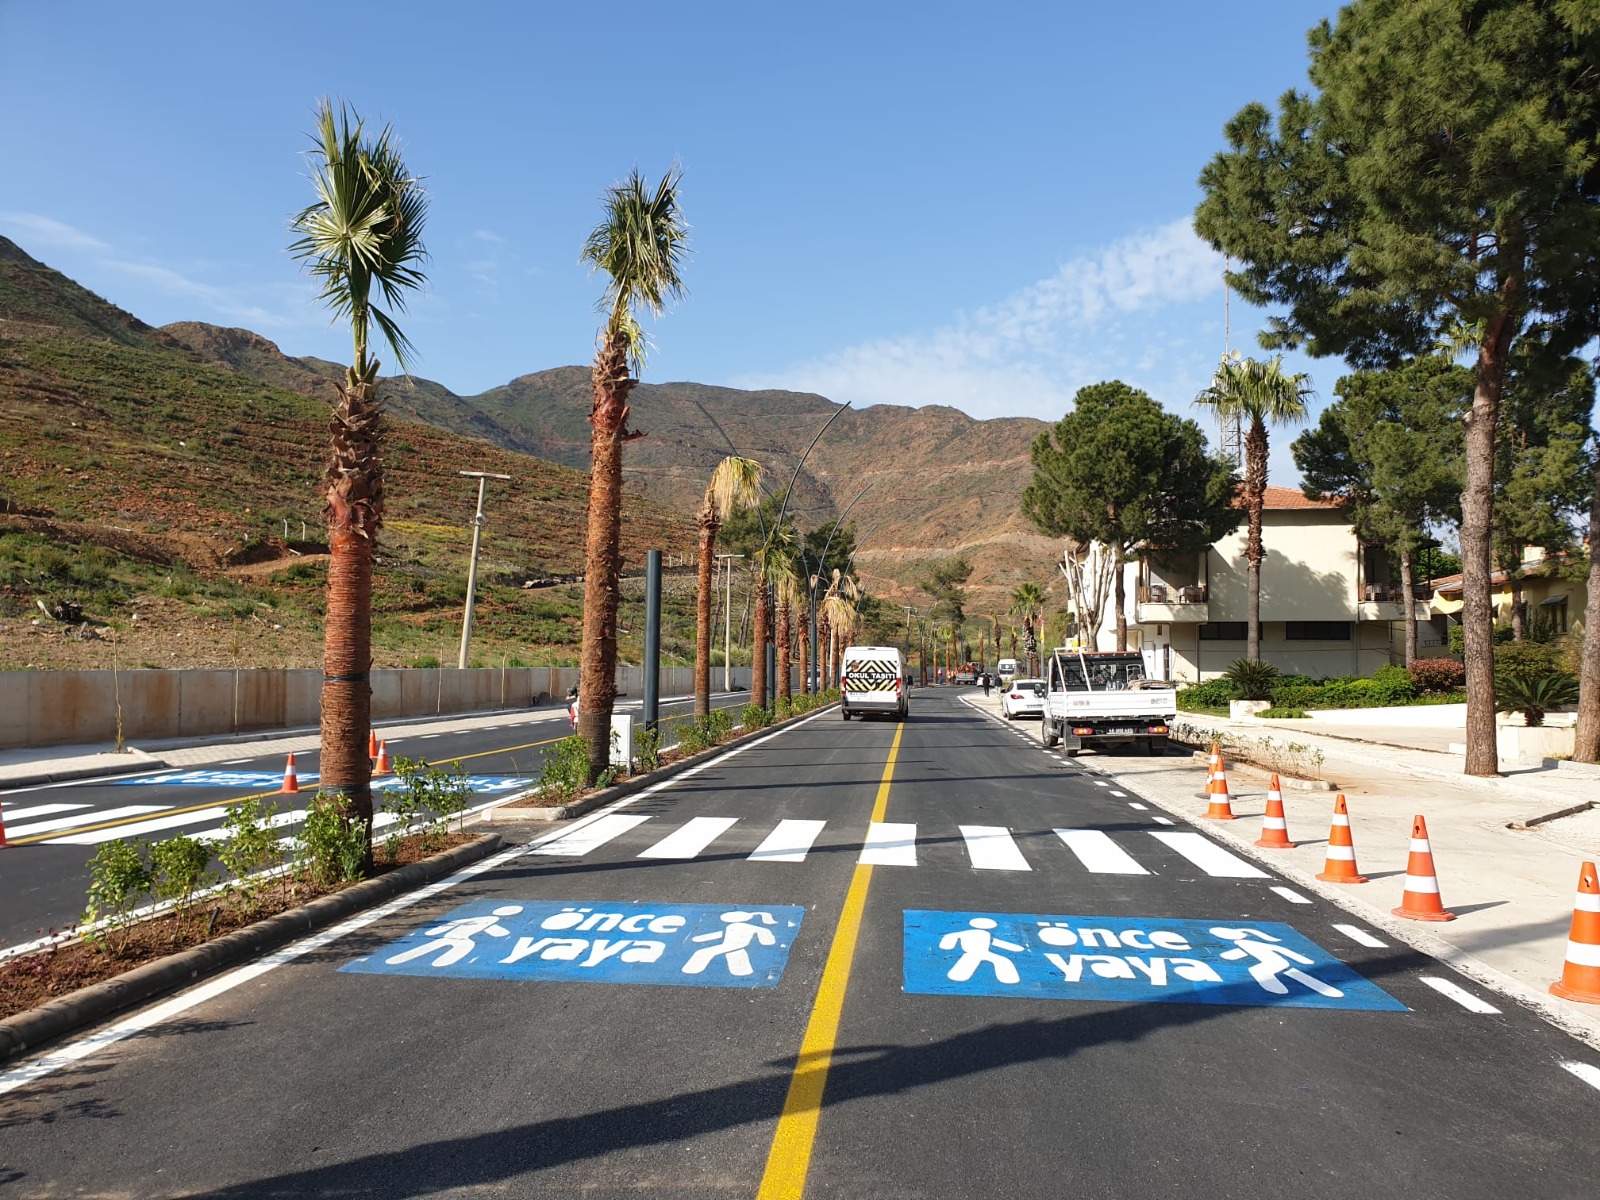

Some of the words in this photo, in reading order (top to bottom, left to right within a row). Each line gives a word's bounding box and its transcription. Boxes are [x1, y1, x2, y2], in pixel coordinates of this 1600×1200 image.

[541, 908, 686, 932] önce
[1037, 922, 1192, 950] önce
[498, 937, 665, 966] yaya
[1044, 953, 1223, 985] yaya
